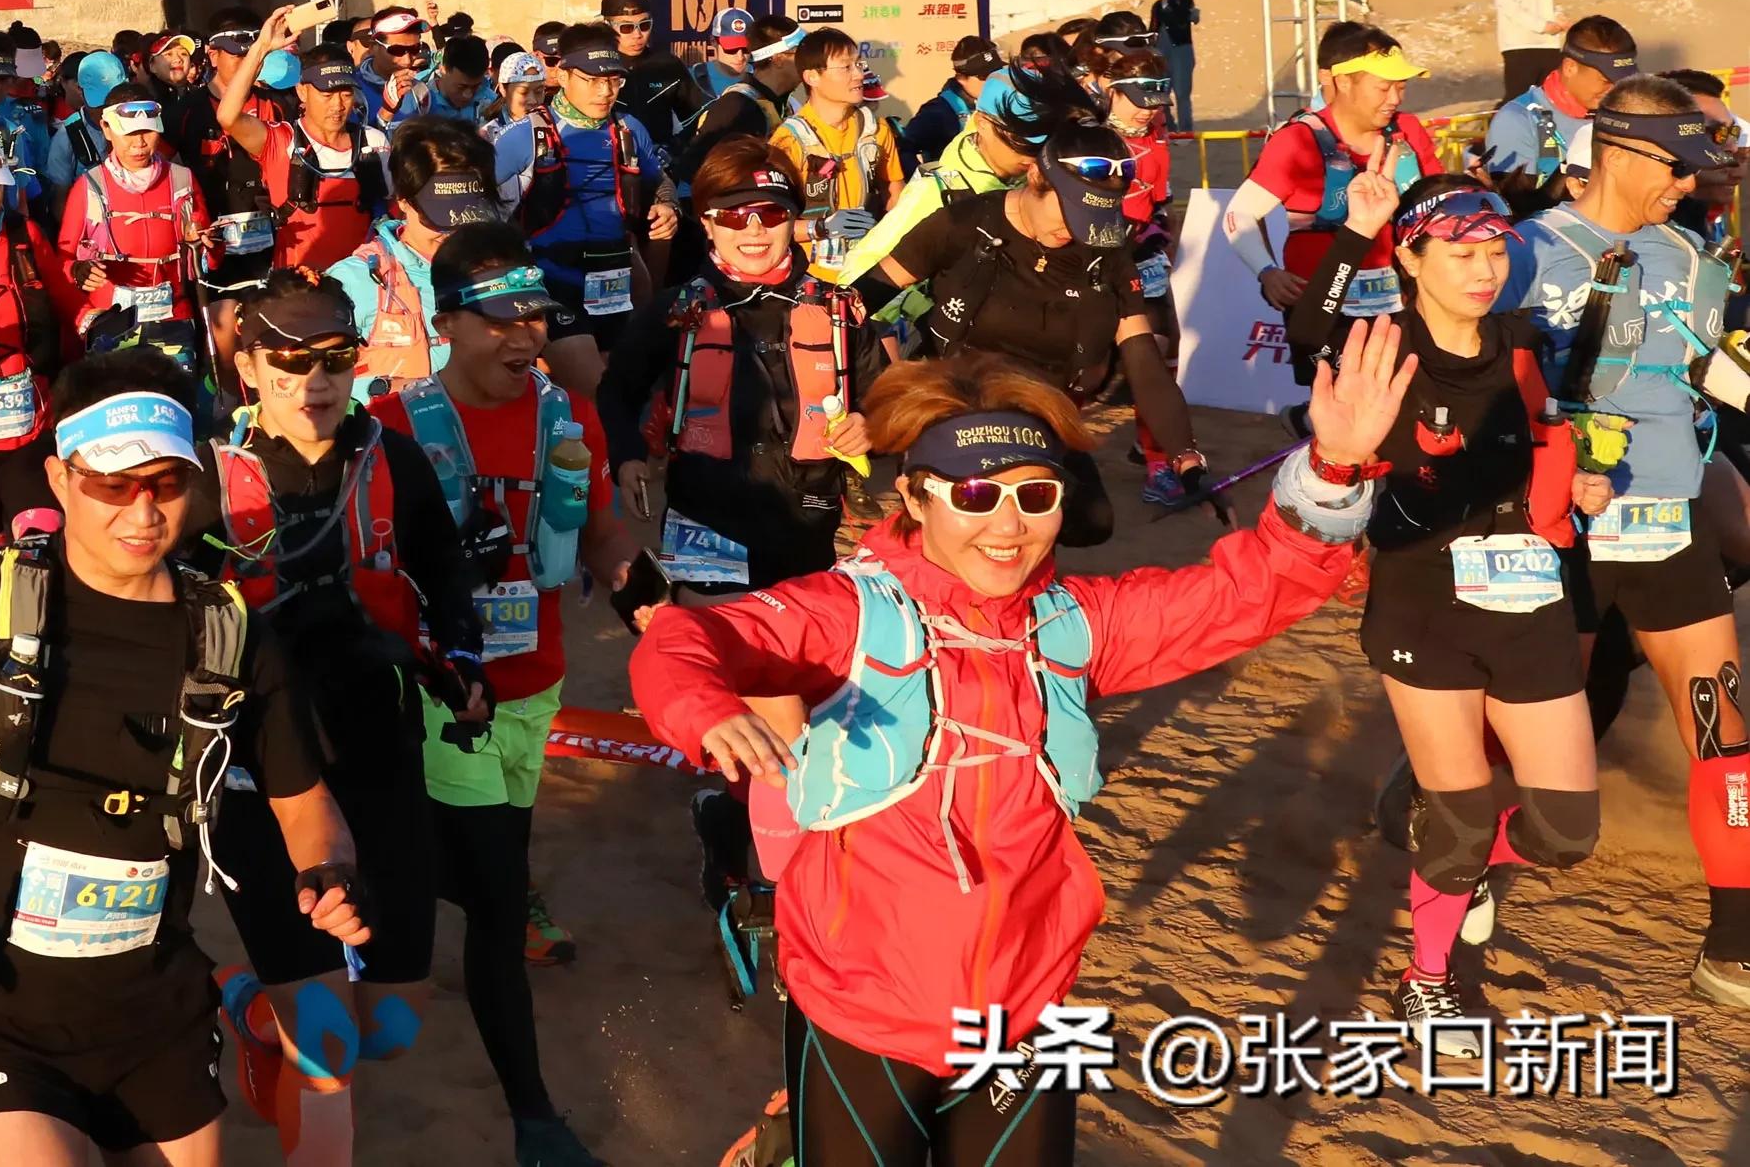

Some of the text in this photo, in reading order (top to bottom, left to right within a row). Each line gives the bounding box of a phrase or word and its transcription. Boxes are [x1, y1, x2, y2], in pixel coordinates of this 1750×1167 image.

[955, 425, 1047, 449] YOUZHOU 100
[956, 434, 1013, 448] ULTRA TRAIL
[1629, 505, 1684, 524] 1168
[1494, 552, 1556, 573] 0202
[481, 601, 530, 622] 130
[1699, 693, 1711, 702] KT
[76, 882, 158, 909] 6121
